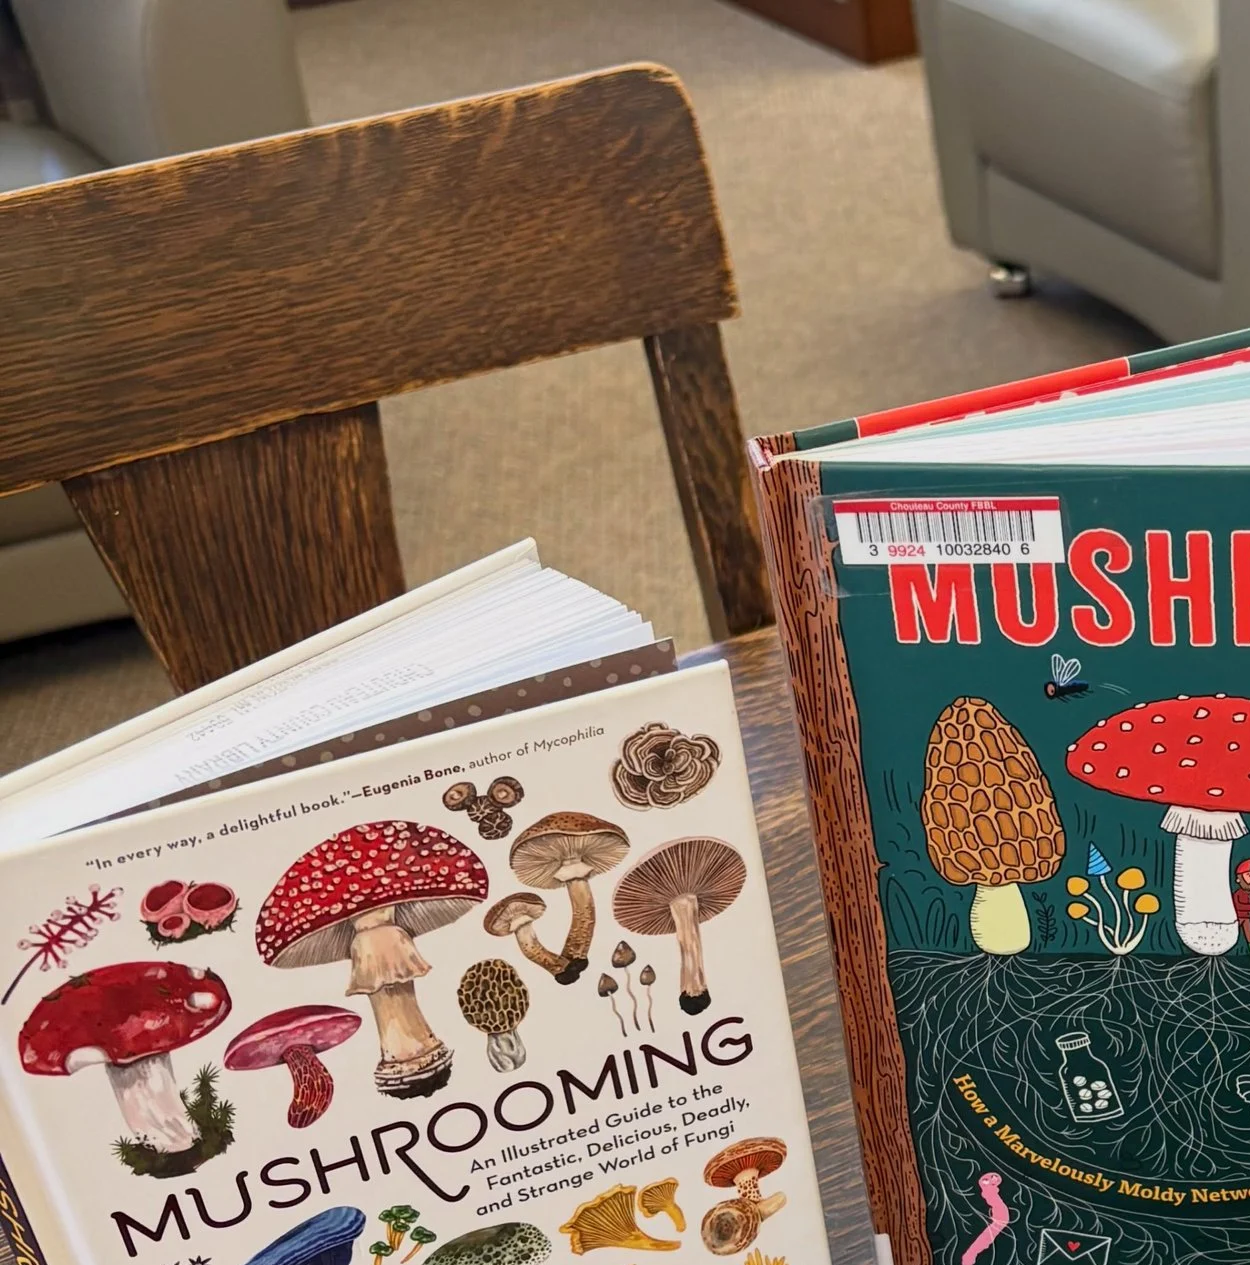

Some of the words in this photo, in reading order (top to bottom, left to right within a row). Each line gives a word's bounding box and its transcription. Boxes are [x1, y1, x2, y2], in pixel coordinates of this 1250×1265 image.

[869, 544, 879, 557] 3
[888, 544, 926, 557] 9924
[936, 543, 1011, 556] 10032840
[1020, 543, 1030, 555] 6
[889, 502, 934, 511] Chouteau
[936, 501, 969, 512] County
[971, 500, 997, 510] FBBL
[117, 845, 162, 866] every
[167, 836, 203, 852] way,
[206, 831, 216, 841] a
[219, 804, 298, 837] delightful
[423, 763, 466, 782] Bone,
[468, 751, 512, 770] author
[516, 743, 530, 757] of
[532, 725, 605, 753] Mycophilia
[110, 1016, 754, 1259] MUSHROOMING
[469, 1156, 496, 1174] An
[500, 1119, 600, 1163] Illustrated
[605, 1101, 663, 1129] Guide
[667, 1095, 688, 1109] to
[692, 1082, 724, 1101] the
[476, 1197, 513, 1217] and
[517, 1169, 594, 1203] Strange
[598, 1146, 655, 1175] World
[660, 1136, 680, 1156] of
[684, 1120, 736, 1149] Fungi
[486, 1152, 584, 1191] Fantastic,
[587, 1124, 678, 1158] Delicious,
[681, 1097, 751, 1127] Deadly,
[952, 1073, 990, 1115] How
[983, 1114, 998, 1129] a
[993, 1123, 1117, 1193] Marvelously
[1117, 1179, 1188, 1206] Moldy
